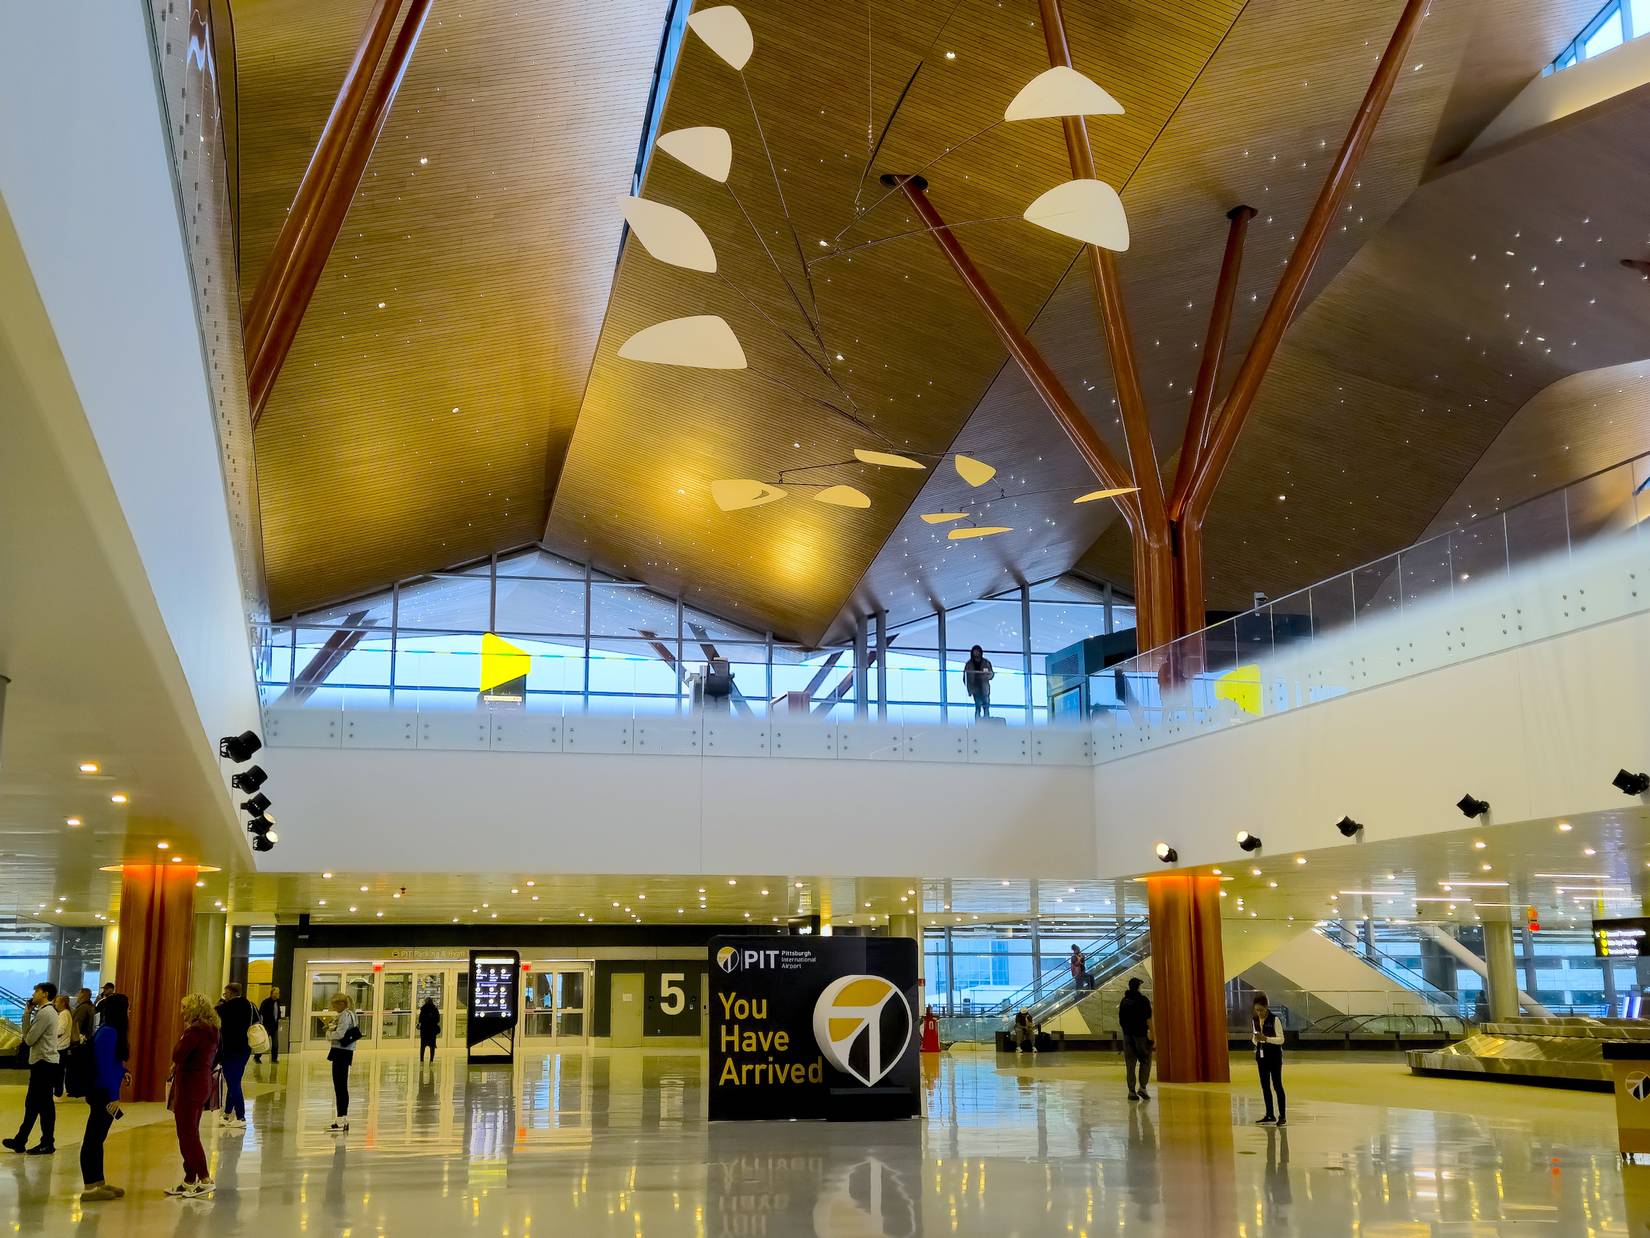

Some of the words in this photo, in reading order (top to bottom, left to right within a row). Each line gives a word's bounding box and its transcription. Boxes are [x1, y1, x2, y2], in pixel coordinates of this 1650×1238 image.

[744, 950, 780, 969] PIT
[660, 972, 685, 1016] 5
[718, 992, 767, 1020] You
[720, 1024, 790, 1053] Have
[718, 1056, 823, 1086] Arrived
